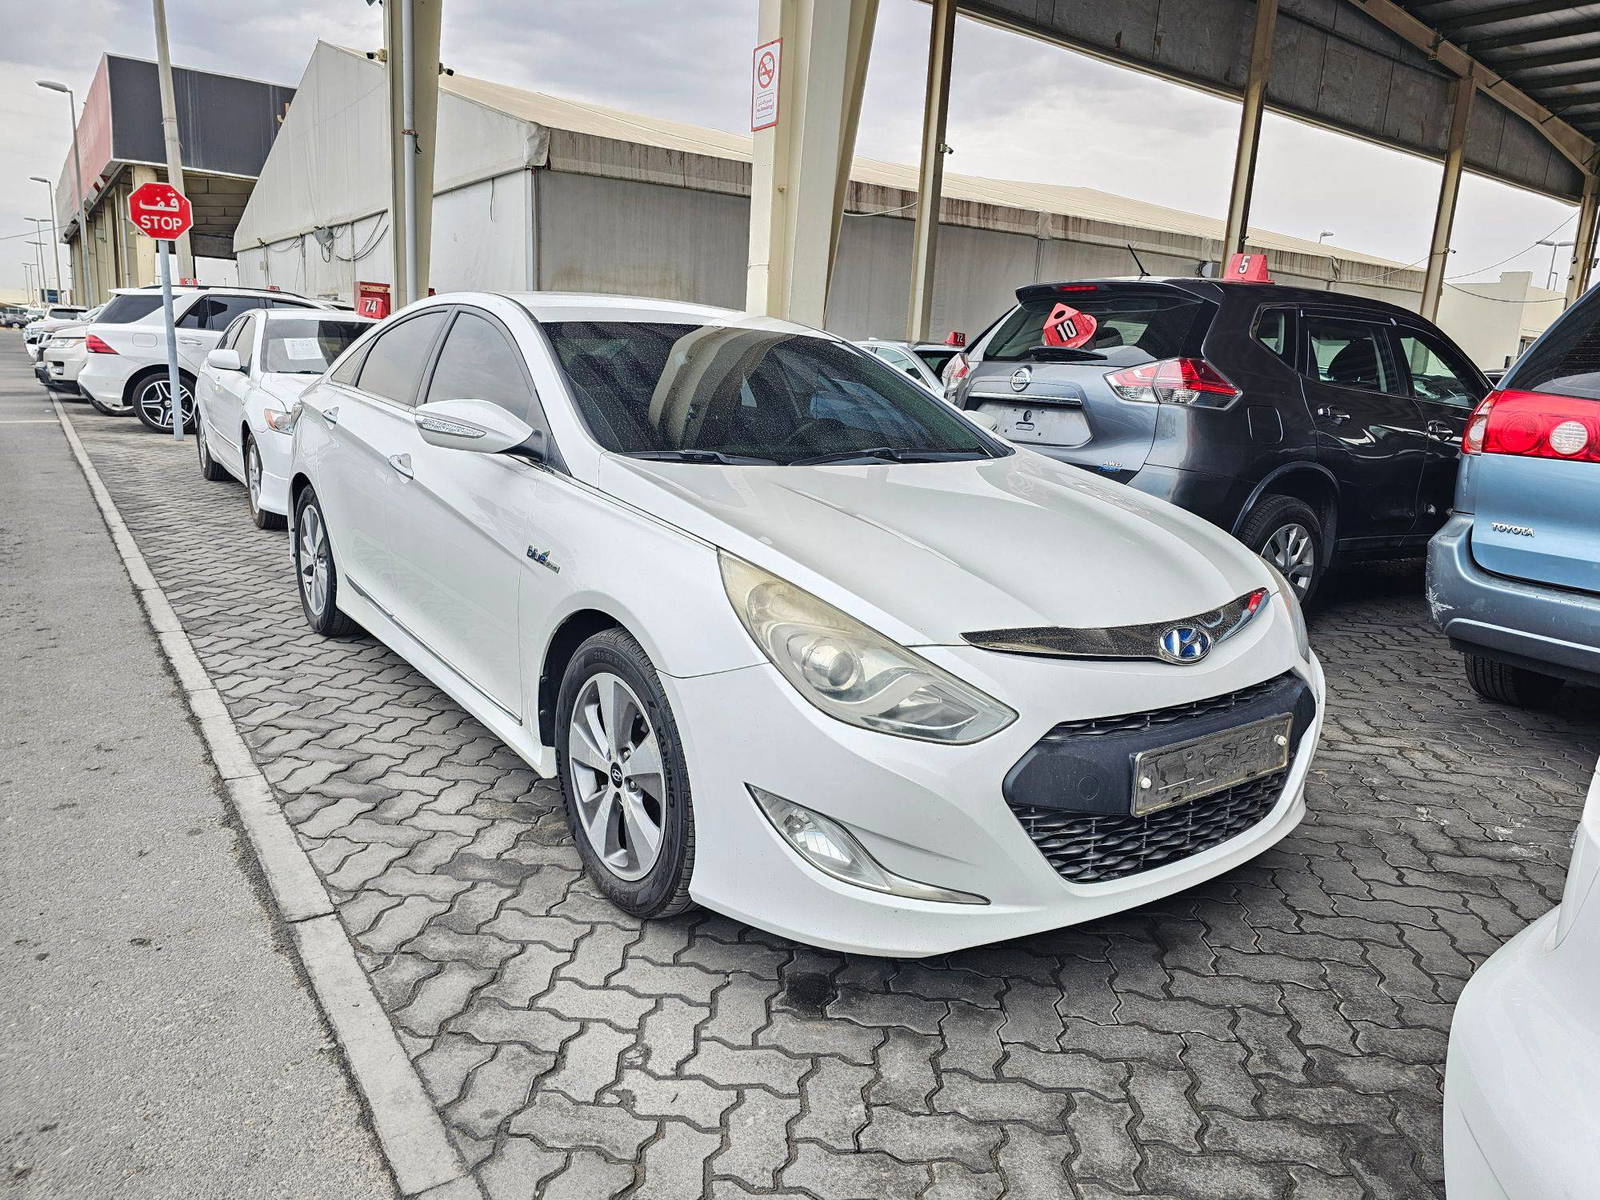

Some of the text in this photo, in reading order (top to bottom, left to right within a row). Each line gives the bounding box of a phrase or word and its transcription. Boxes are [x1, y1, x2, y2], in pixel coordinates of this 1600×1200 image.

[139, 192, 180, 212] قف
[140, 215, 183, 230] STOP
[1238, 255, 1252, 274] 5
[365, 299, 378, 313] 74
[1056, 319, 1078, 342] 10
[1491, 522, 1536, 538] TOYOTA
[657, 726, 675, 809] KUMHO
